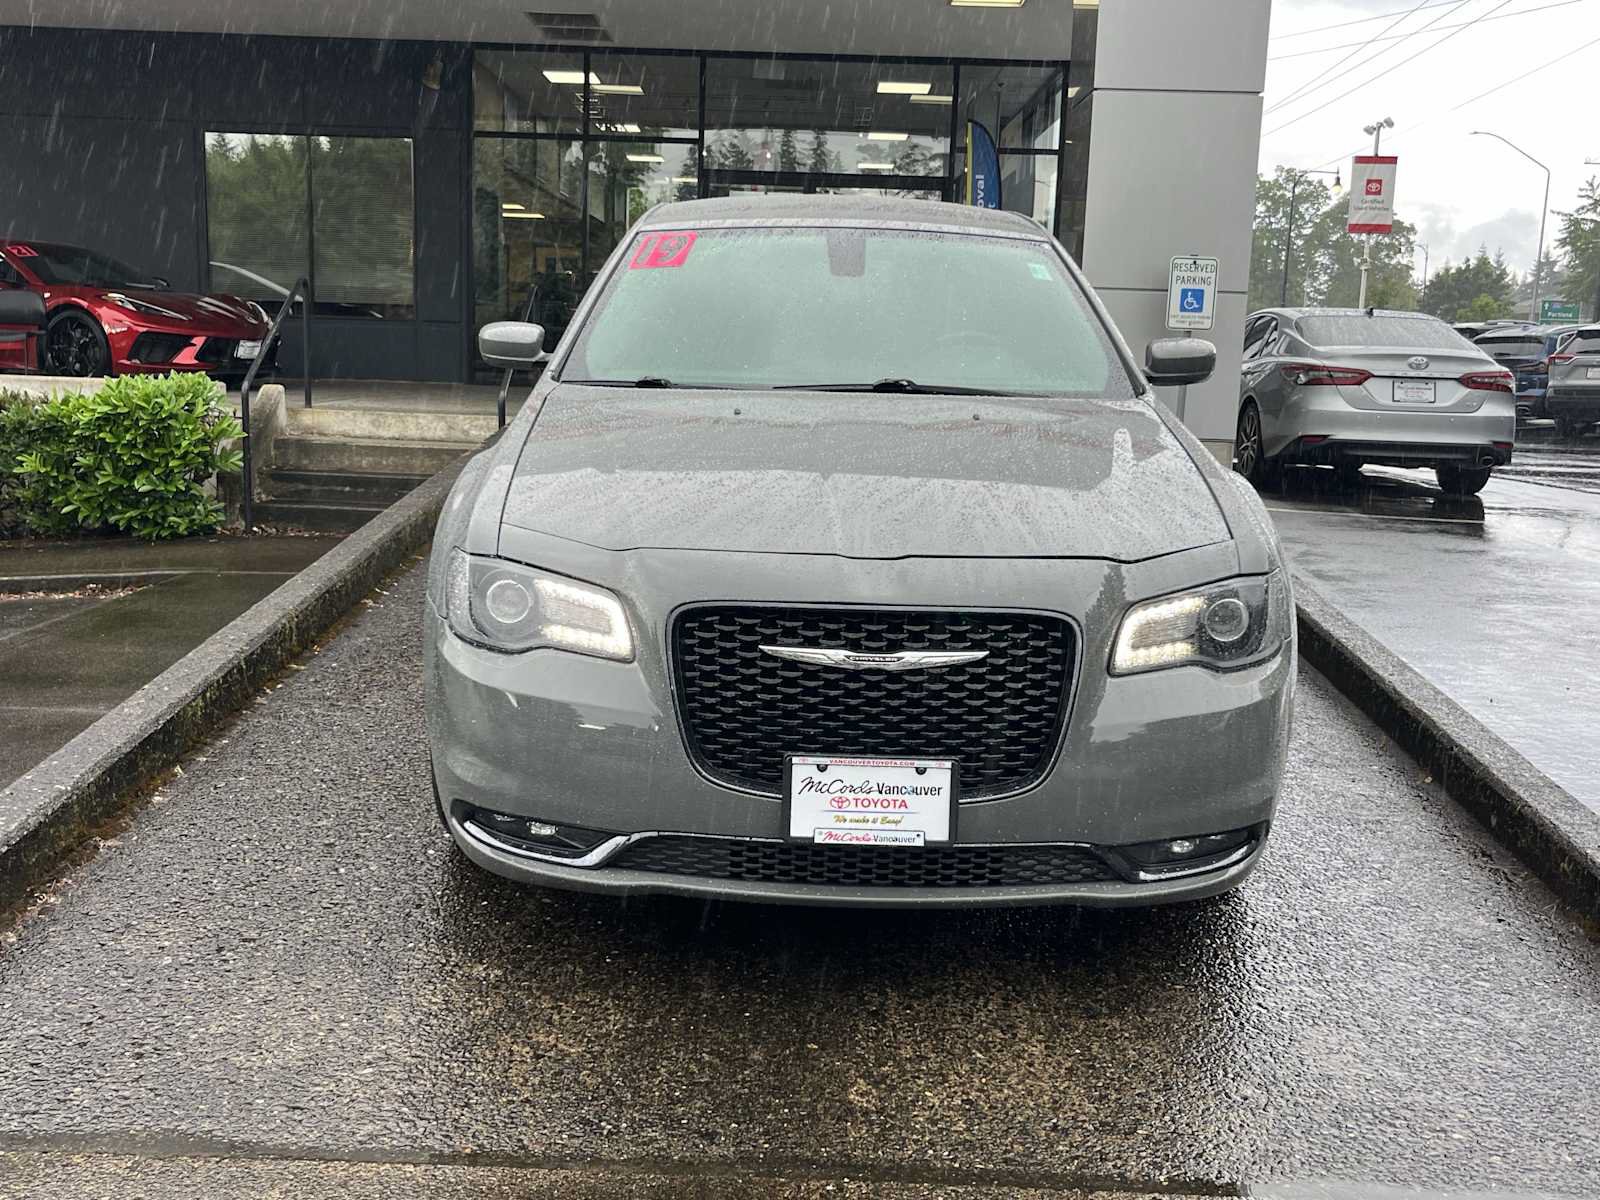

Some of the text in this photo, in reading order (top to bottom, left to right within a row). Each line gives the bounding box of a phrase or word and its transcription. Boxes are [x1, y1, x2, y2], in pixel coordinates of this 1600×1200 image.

[633, 236, 688, 265] 19
[1174, 262, 1216, 274] RESERVED
[1176, 275, 1212, 286] PARKING
[829, 759, 916, 767] VANCOUVERTOYOTA.COM
[876, 782, 943, 797] Vancouver
[853, 797, 909, 809] TOYOTA
